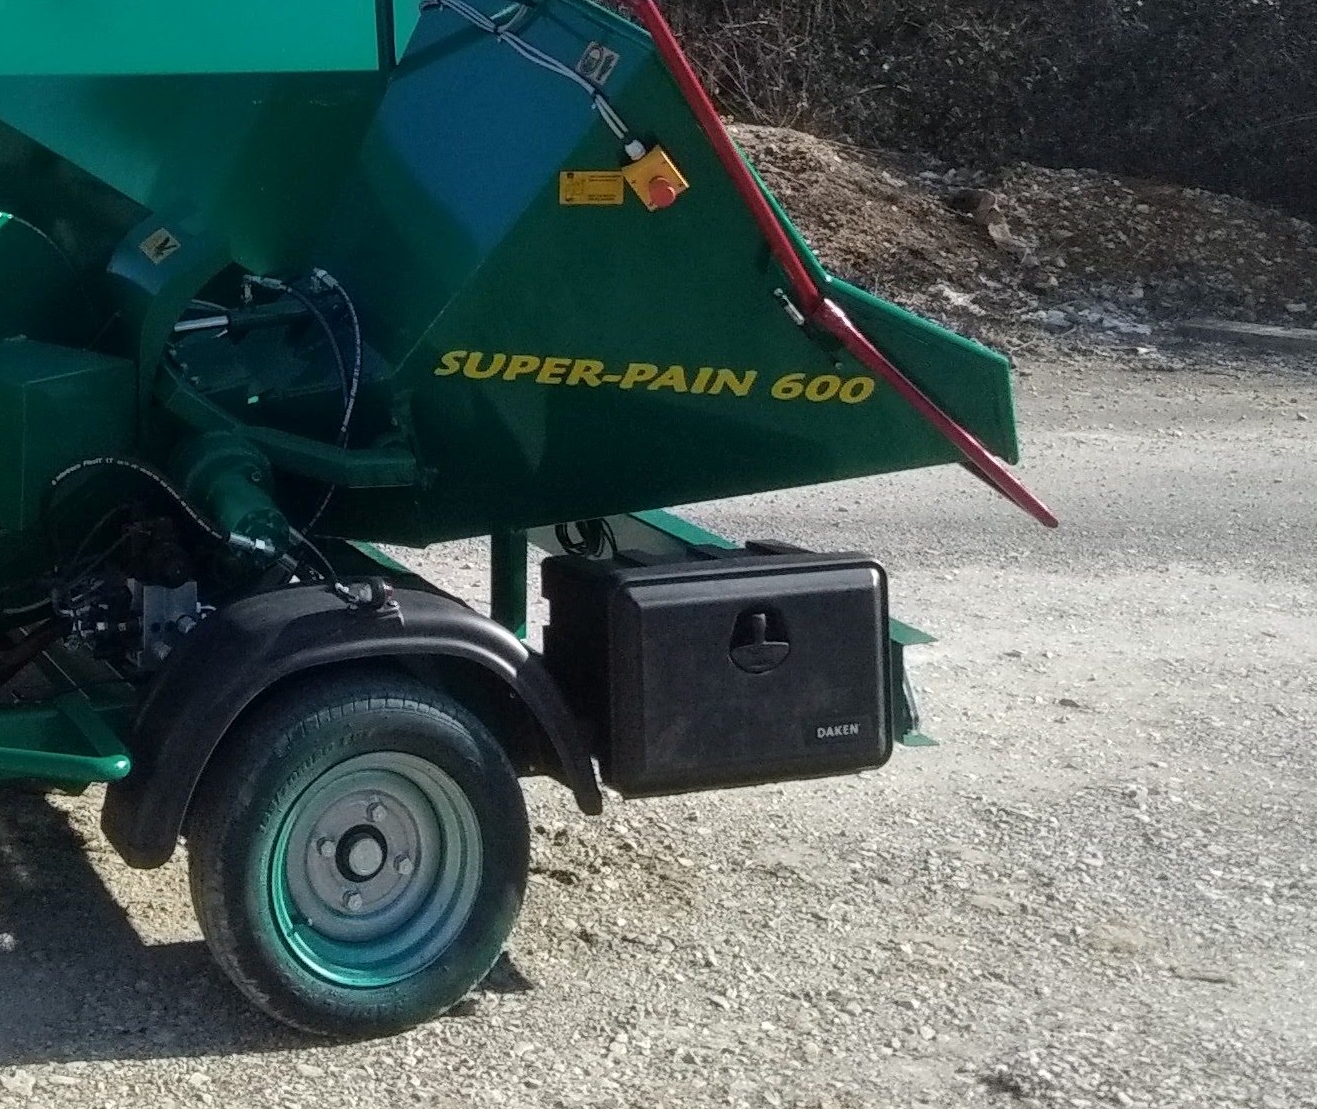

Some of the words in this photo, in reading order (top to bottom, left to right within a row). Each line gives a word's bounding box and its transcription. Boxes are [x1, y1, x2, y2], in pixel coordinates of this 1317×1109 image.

[433, 350, 758, 396] SUPER-PAIN
[770, 373, 875, 404] 600
[816, 723, 860, 739] DAKEN
